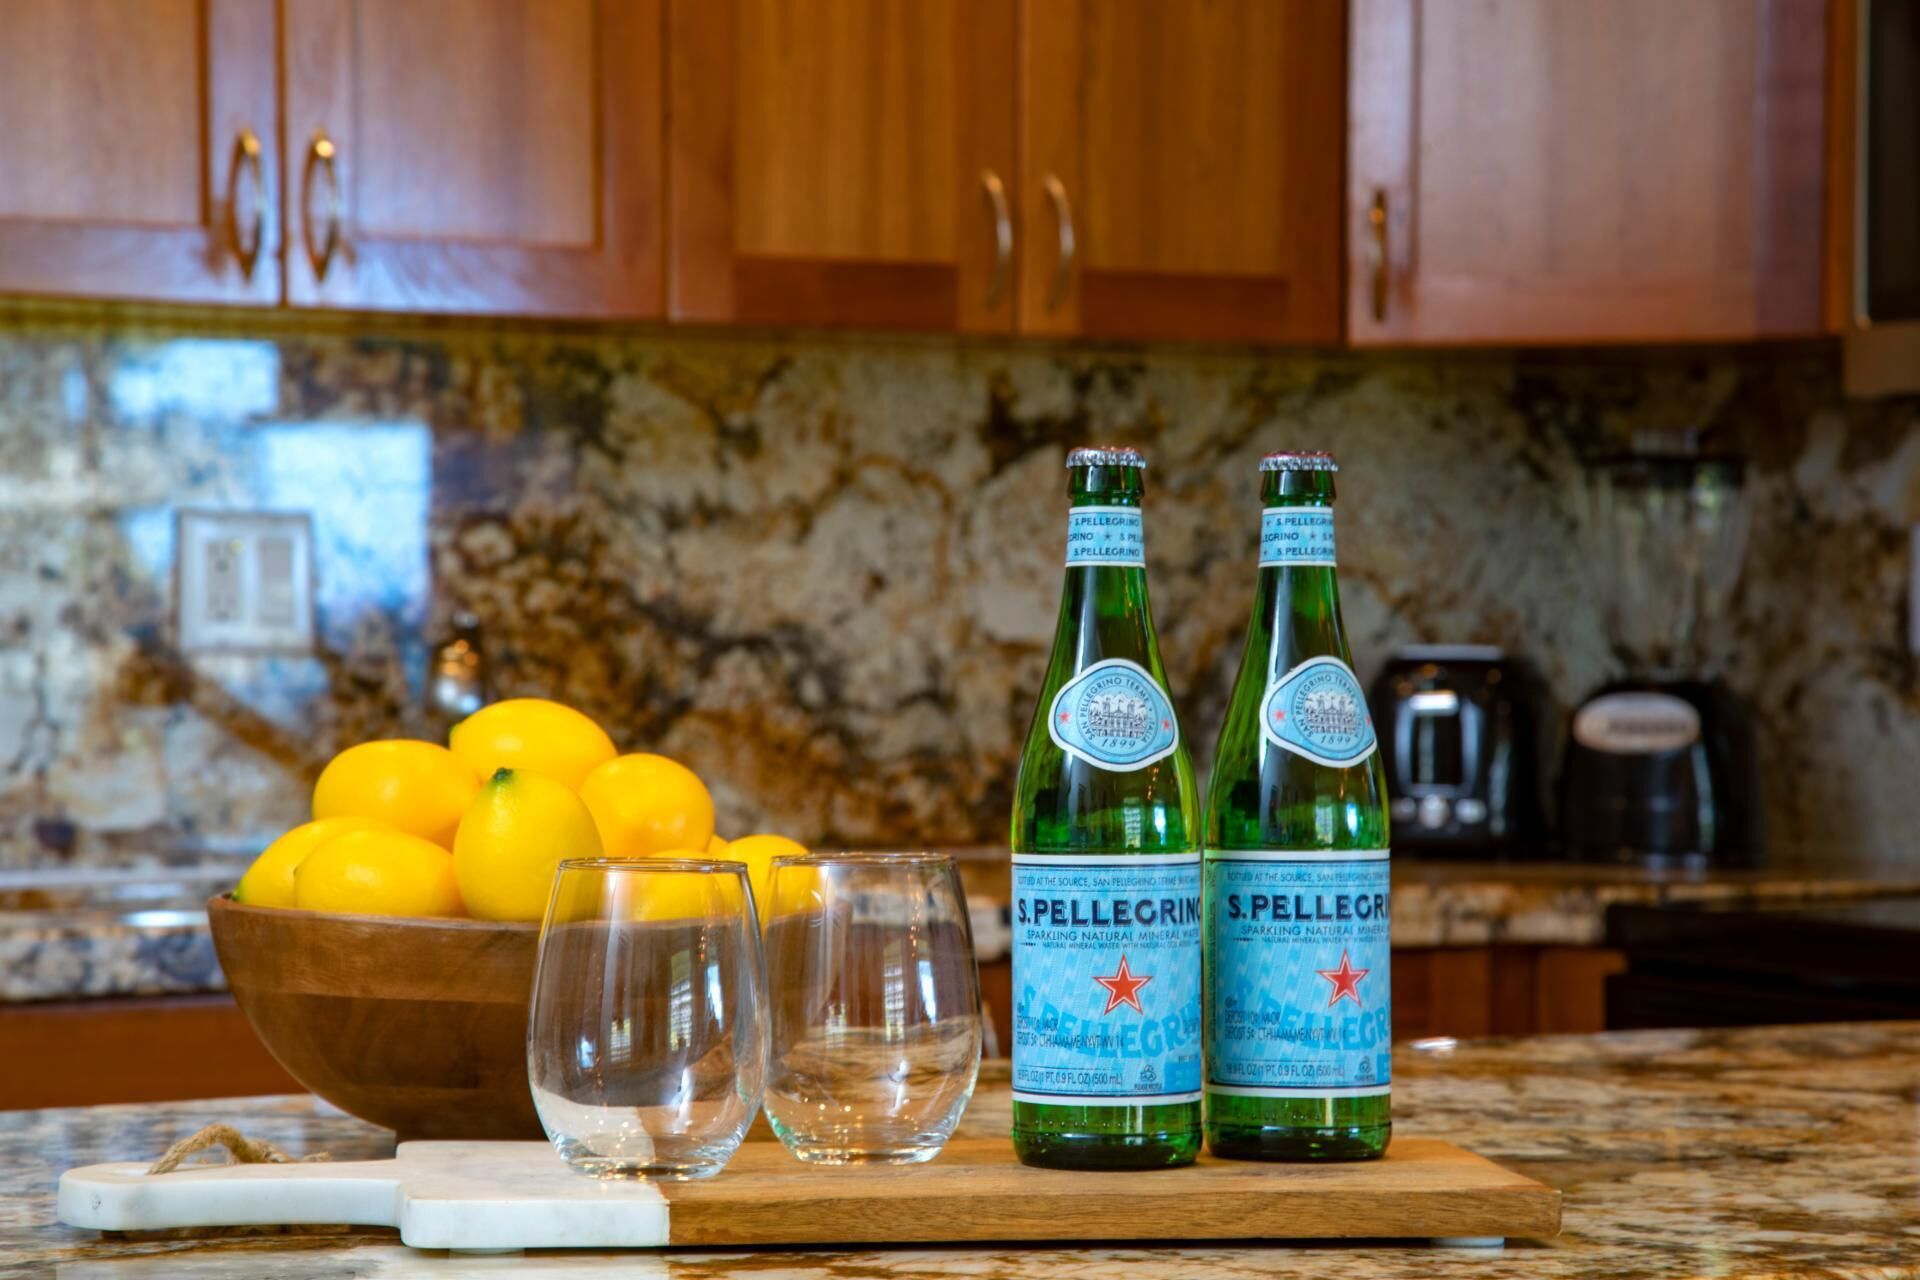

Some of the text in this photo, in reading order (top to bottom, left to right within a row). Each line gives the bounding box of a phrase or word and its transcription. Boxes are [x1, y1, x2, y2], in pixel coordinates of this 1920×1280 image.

[1080, 677, 1122, 718] PELLEGRINO
[1295, 673, 1332, 715] PELLEGRINO
[1080, 723, 1097, 741] SAN
[1101, 738, 1137, 748] 1899
[1320, 735, 1352, 745] 1899
[1058, 877, 1091, 888] SOURCE,
[1027, 930, 1077, 941] SPARKLING
[1082, 931, 1133, 942] NATURAL
[1139, 930, 1180, 941] MINERAL
[1241, 926, 1301, 936] SPARKLING
[1306, 926, 1353, 936] NATURAL
[1279, 1065, 1290, 1076] 0.9
[1291, 1065, 1300, 1077] FL
[1056, 1072, 1067, 1084] 0.9
[1068, 1073, 1077, 1084] FL
[1078, 1073, 1091, 1086] OZ)
